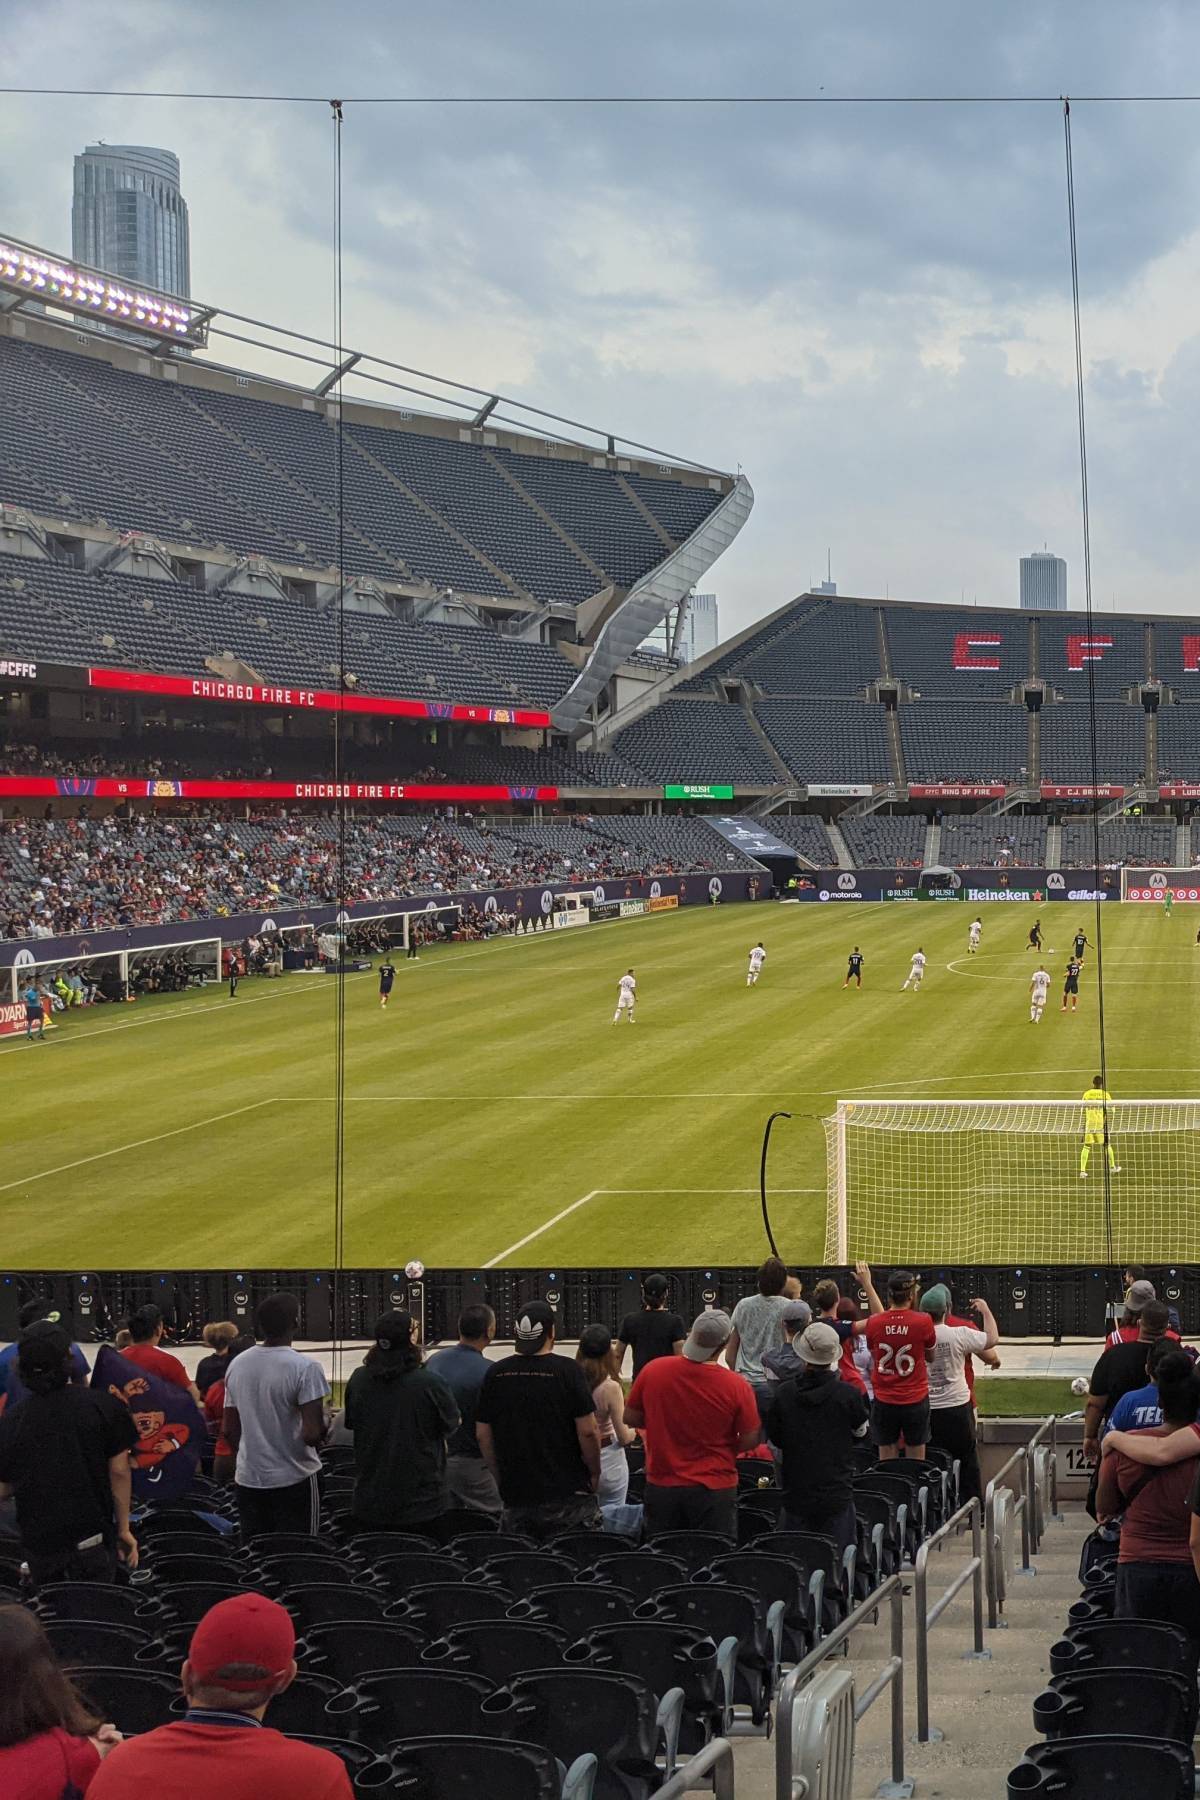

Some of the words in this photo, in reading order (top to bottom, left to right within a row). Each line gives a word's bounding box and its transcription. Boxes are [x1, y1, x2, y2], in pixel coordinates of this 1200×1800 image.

[0, 661, 36, 679] #CFFC
[192, 681, 253, 700] CHICAGO
[262, 688, 291, 703] FIRE
[300, 692, 315, 705] FC
[118, 784, 127, 793] VS
[295, 784, 351, 796] CHICAGO
[357, 785, 384, 797] FIRE
[390, 786, 405, 798] FC
[942, 788, 960, 796] RING
[974, 788, 991, 796] FIRE
[830, 891, 862, 900] motorola
[968, 889, 1030, 901] Heineken
[885, 1325, 909, 1335] DEAN
[878, 1343, 915, 1377] 26
[394, 1777, 418, 1788] verizon
